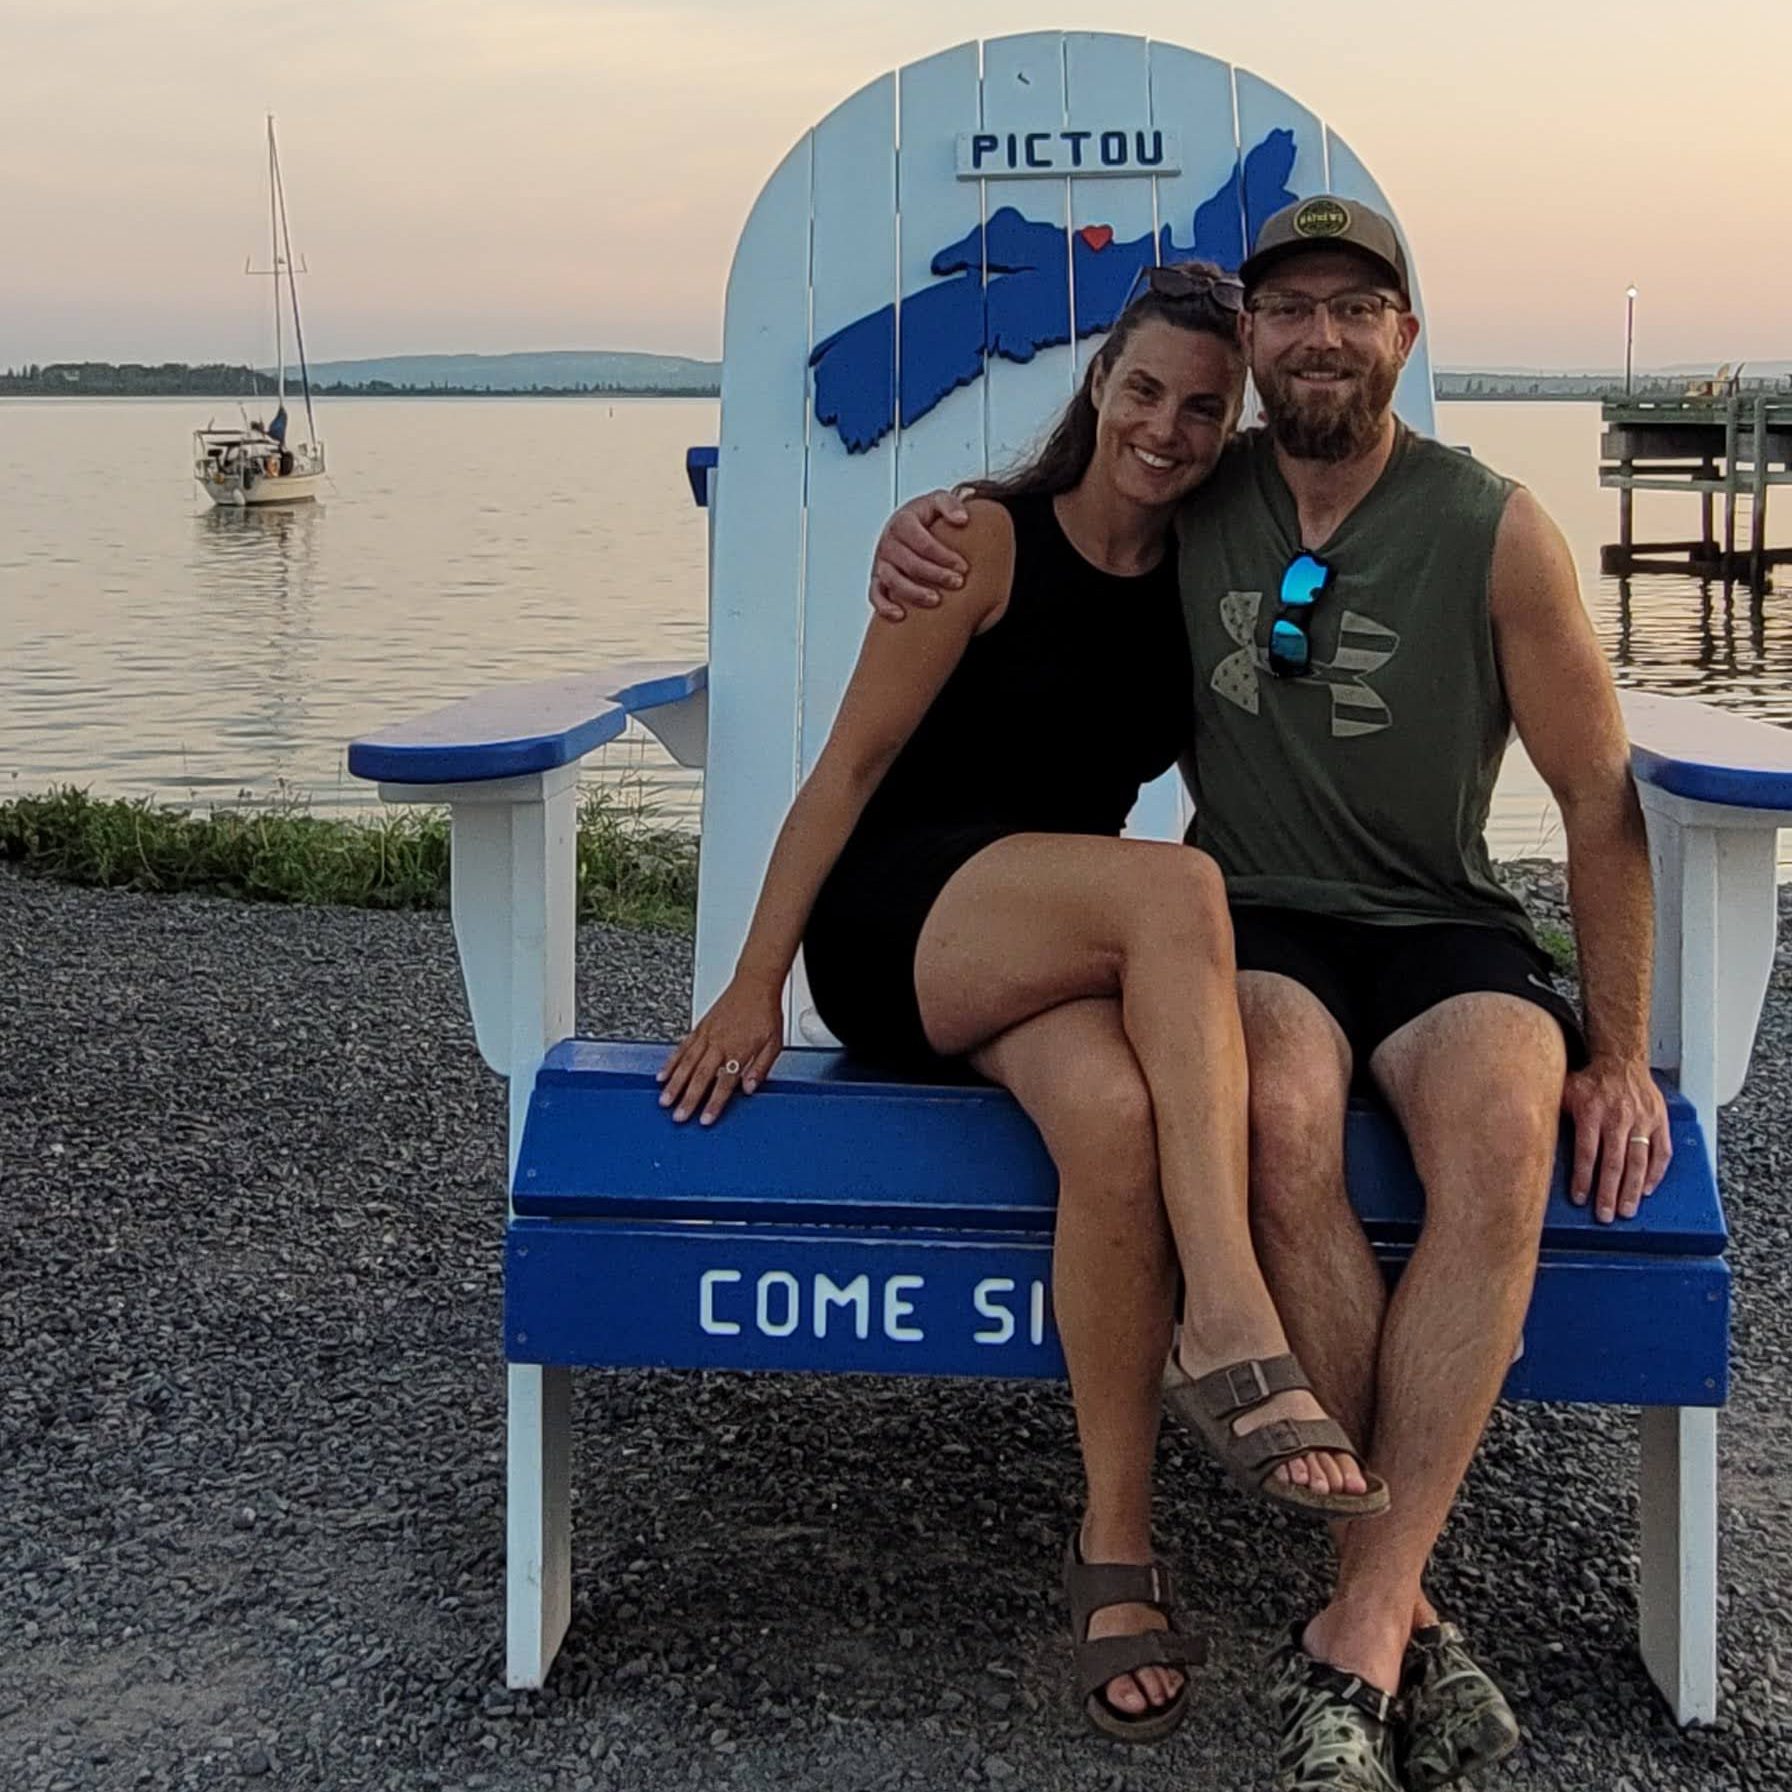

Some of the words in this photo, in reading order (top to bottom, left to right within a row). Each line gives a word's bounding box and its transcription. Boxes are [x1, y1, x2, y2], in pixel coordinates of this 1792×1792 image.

[972, 130, 1164, 169] PICTOU
[700, 1269, 925, 1342] COME
[973, 1278, 1044, 1346] SI
